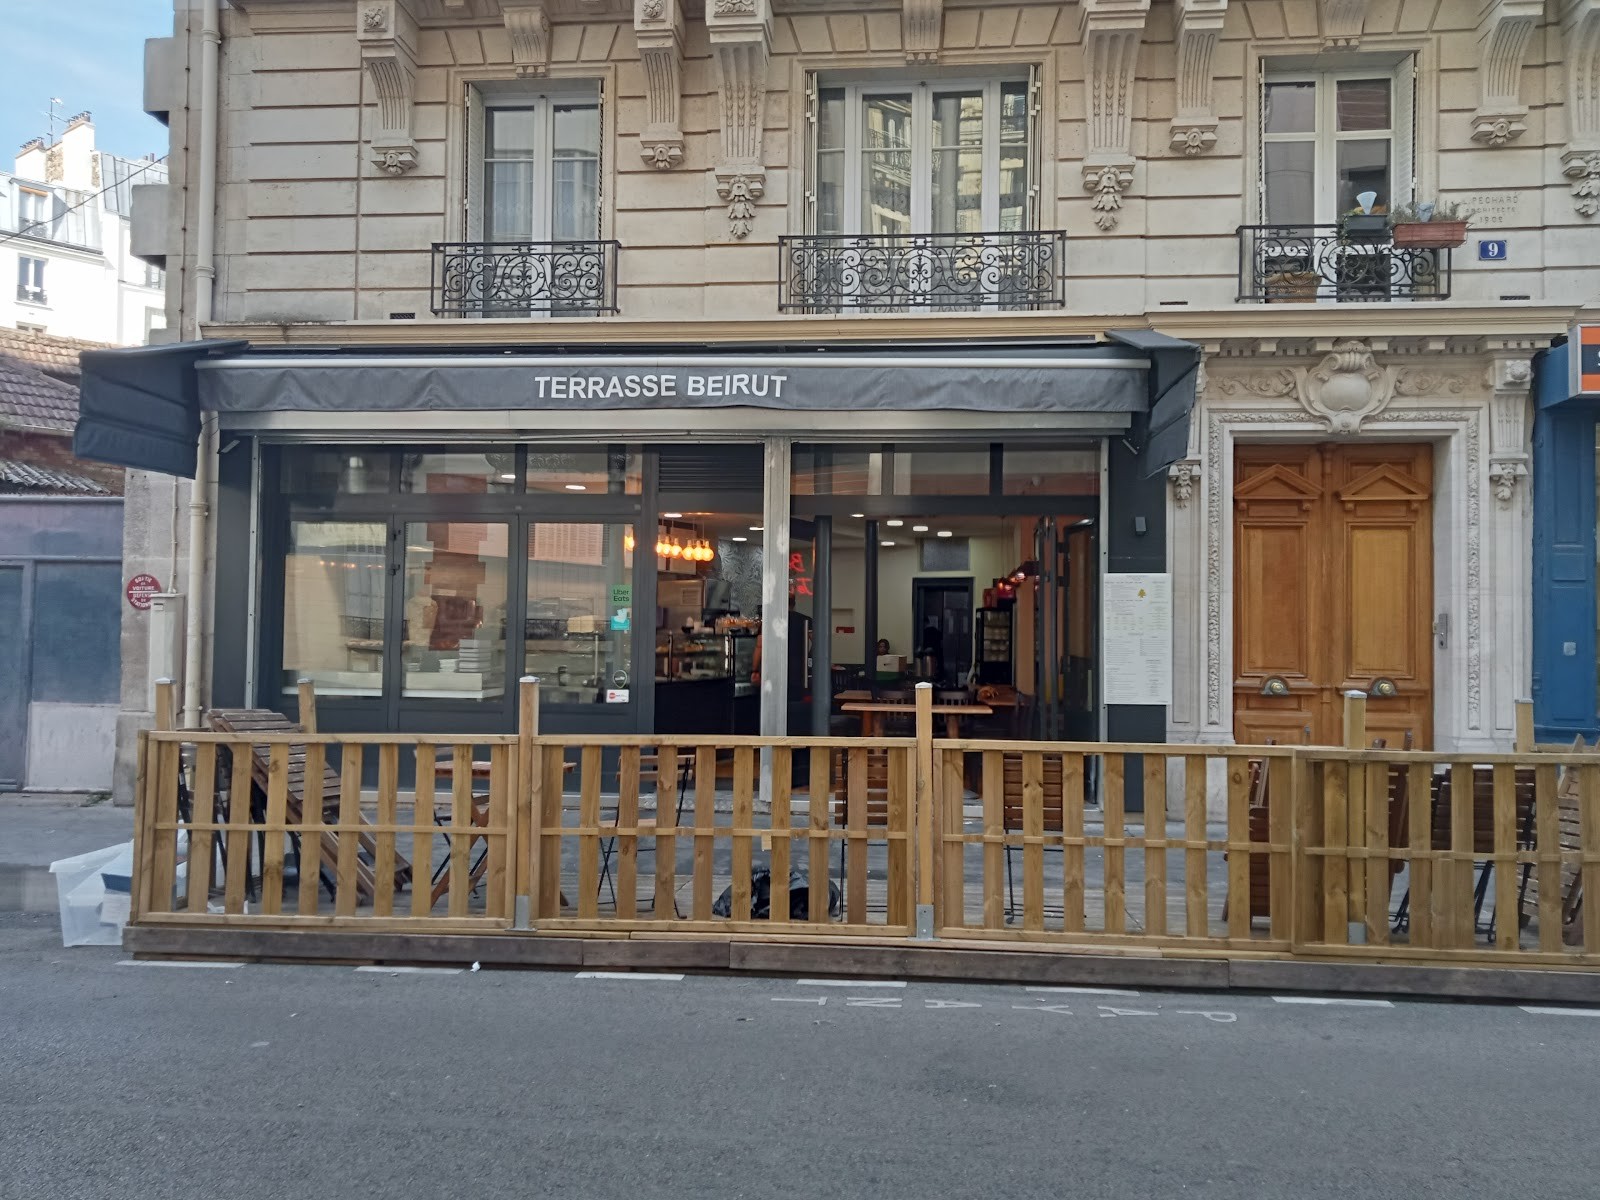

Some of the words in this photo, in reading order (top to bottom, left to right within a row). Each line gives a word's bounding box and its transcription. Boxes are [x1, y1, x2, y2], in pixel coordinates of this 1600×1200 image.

[1488, 242, 1499, 257] 9
[534, 375, 677, 399] TERRASSE
[687, 373, 788, 398] BEIRUT
